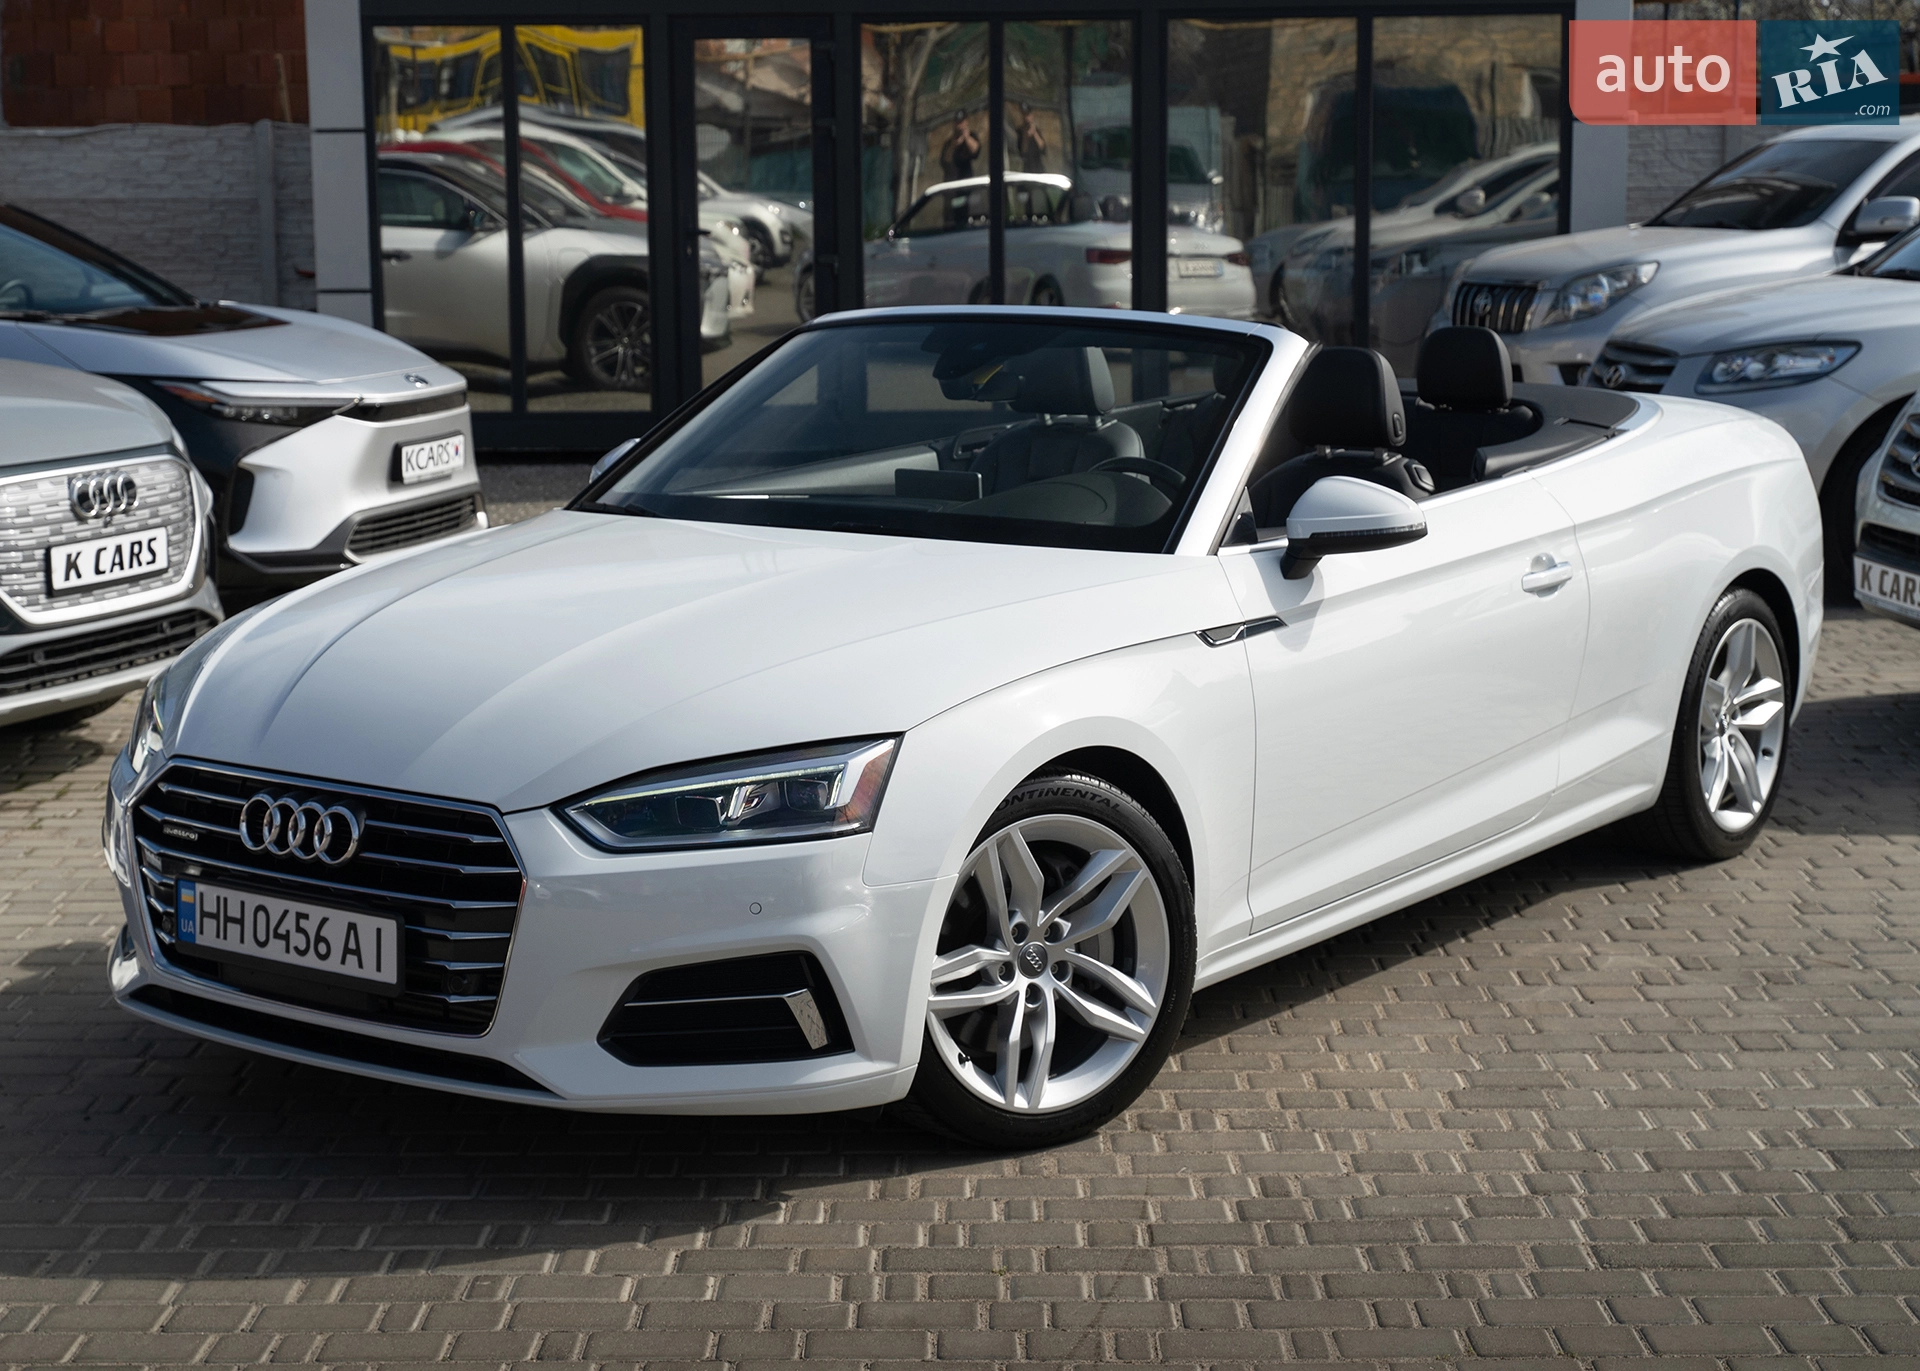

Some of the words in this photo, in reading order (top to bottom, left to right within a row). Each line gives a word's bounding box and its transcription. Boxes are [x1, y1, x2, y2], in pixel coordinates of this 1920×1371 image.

[64, 551, 82, 582] K
[94, 537, 156, 575] CARS
[1861, 563, 1873, 592] K
[1878, 569, 1920, 607] CAR
[181, 918, 195, 934] UA
